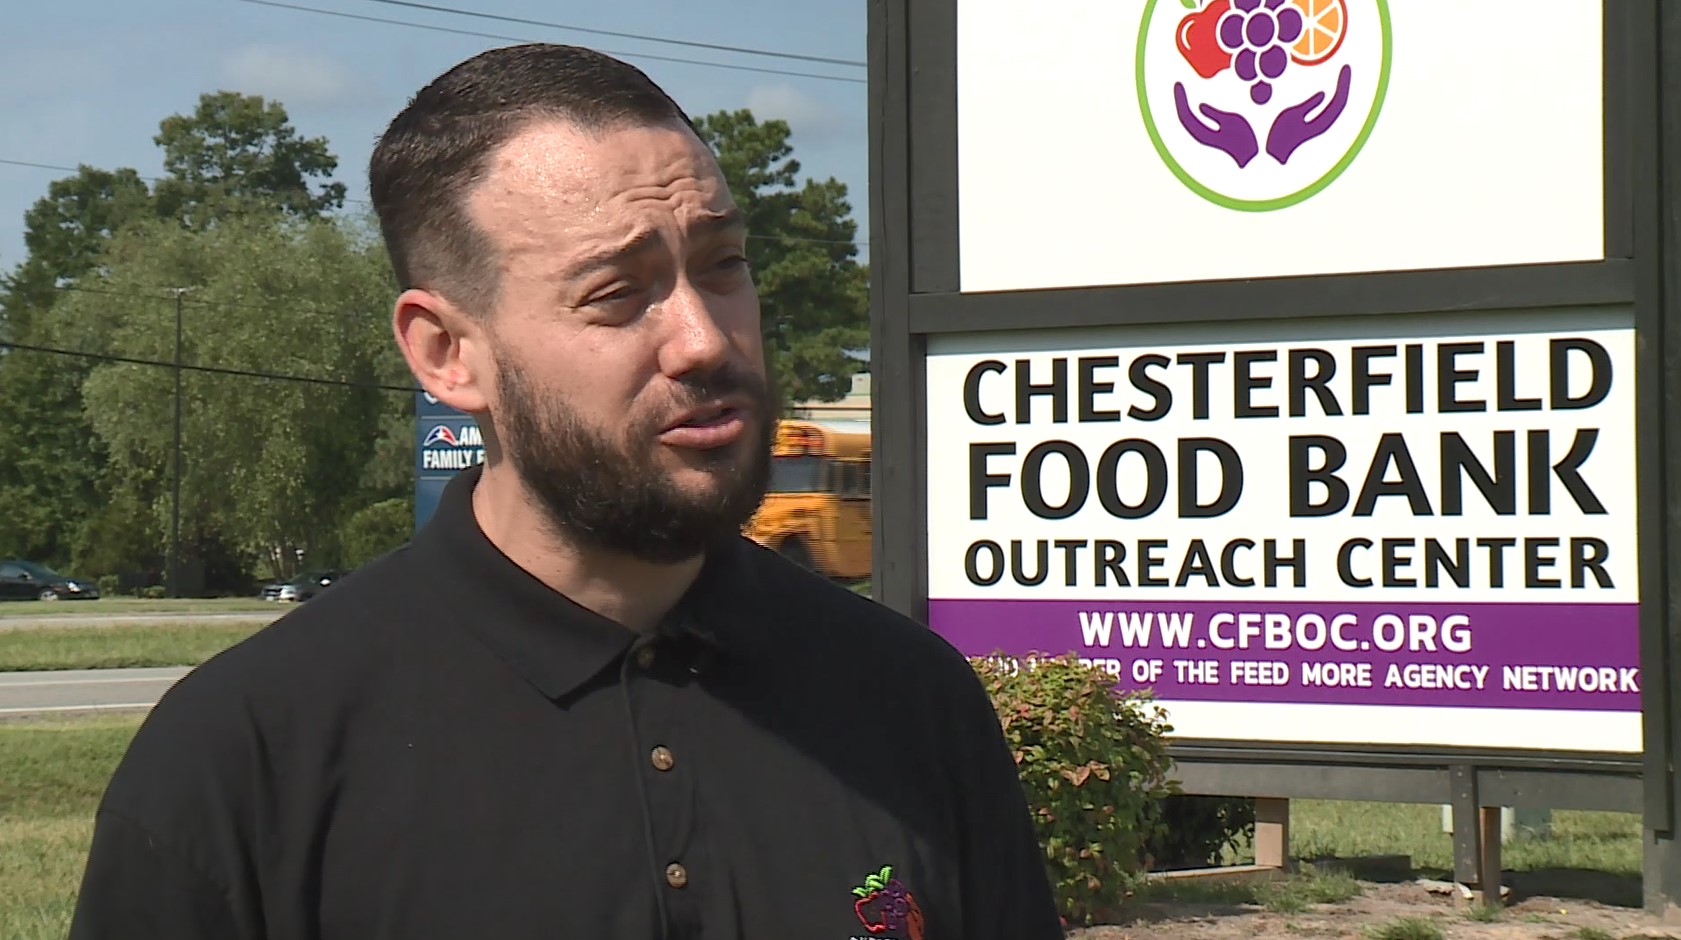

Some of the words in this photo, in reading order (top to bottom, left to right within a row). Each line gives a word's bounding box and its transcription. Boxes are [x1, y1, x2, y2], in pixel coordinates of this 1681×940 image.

[963, 336, 1613, 426] CHESTERFIELD
[459, 426, 483, 446] AM
[422, 449, 473, 469] FAMILY
[969, 437, 1244, 521] FOOD
[1288, 428, 1609, 518] BANK
[964, 538, 1306, 588] OUTREACH
[1336, 536, 1615, 590] CENTER
[1078, 611, 1472, 653] WWW.CFBOC.ORG
[1132, 659, 1164, 682] OF
[1173, 660, 1219, 684] THE
[1229, 661, 1290, 685] FEED
[1301, 662, 1372, 687] MORE
[1384, 663, 1490, 690] AGENCY
[1502, 665, 1640, 693] NETWORK
